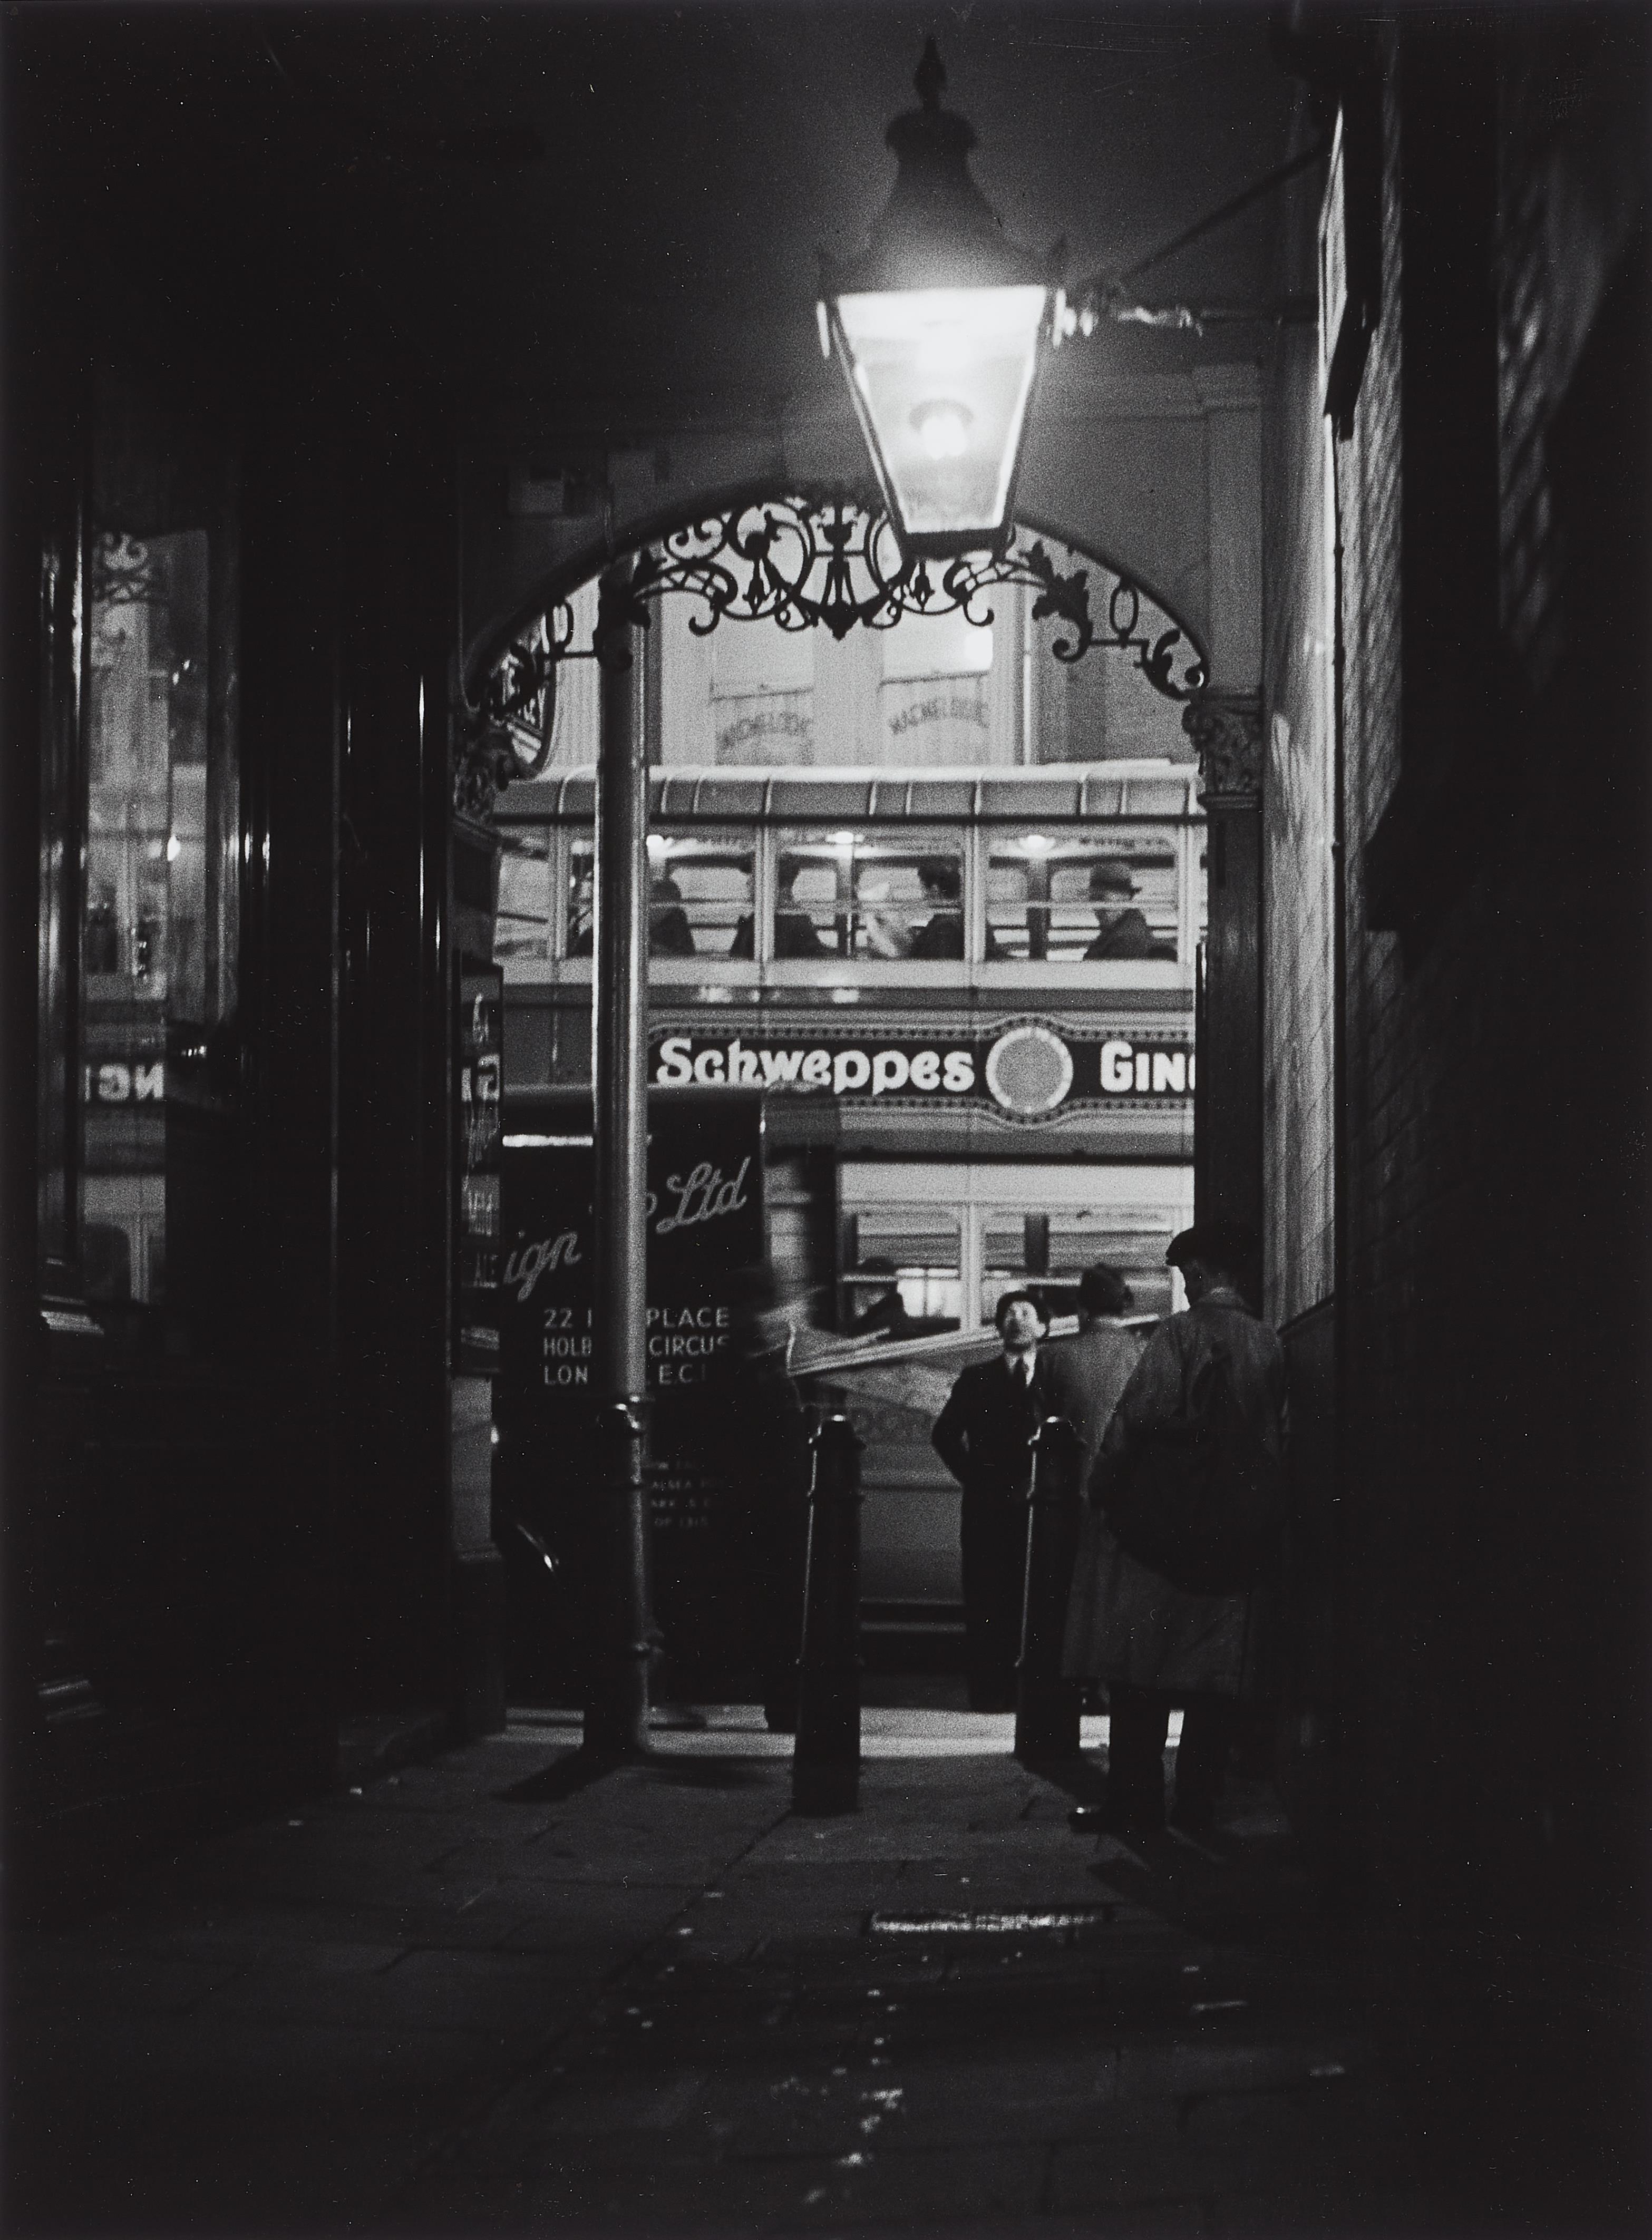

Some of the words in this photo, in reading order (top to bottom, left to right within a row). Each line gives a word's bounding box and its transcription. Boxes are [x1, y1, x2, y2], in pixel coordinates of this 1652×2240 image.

[657, 1037, 975, 1095] Schweppes
[1101, 1040, 1196, 1092] GIN
[503, 1230, 581, 1302] ign
[656, 1156, 751, 1235] Ltd
[543, 1308, 573, 1329] 22
[646, 1307, 730, 1328] PLACE
[543, 1336, 592, 1357] HOLB
[543, 1365, 589, 1385] LON
